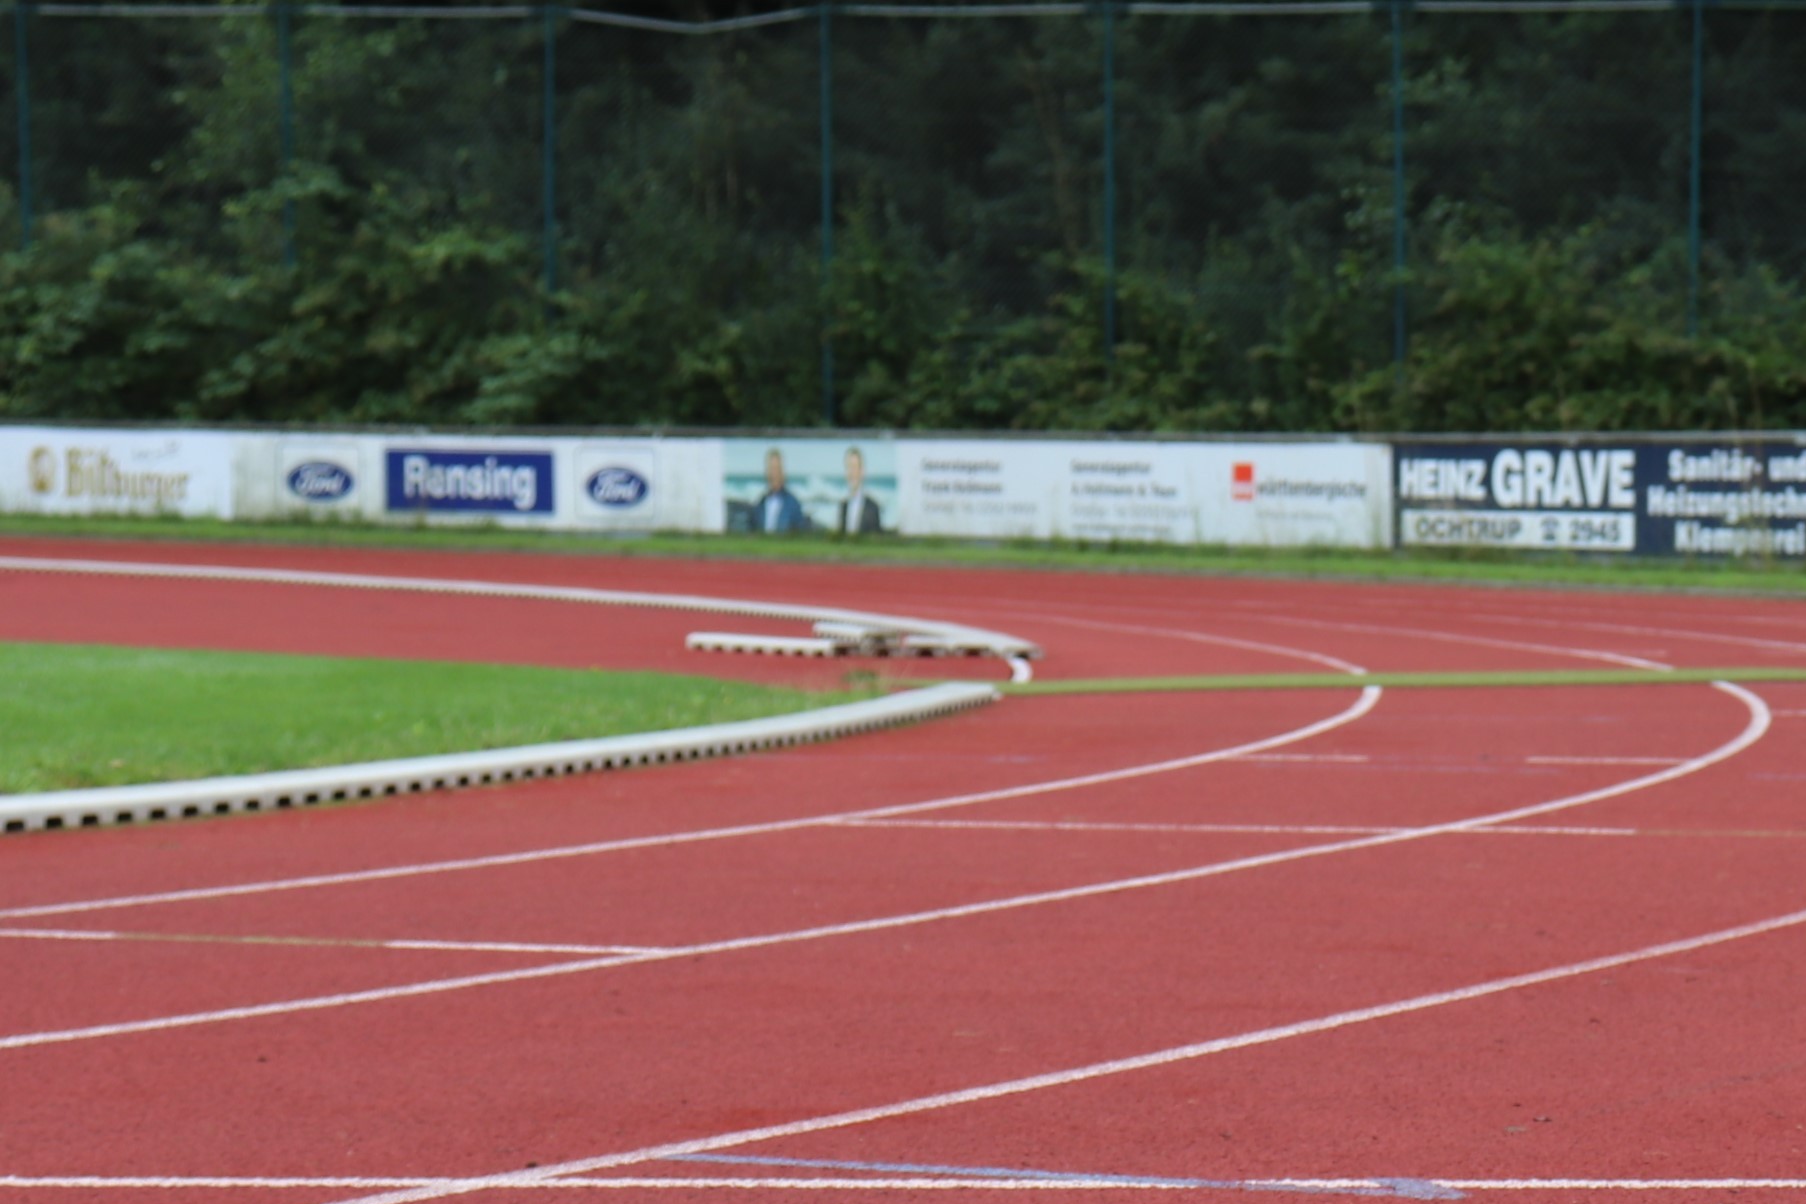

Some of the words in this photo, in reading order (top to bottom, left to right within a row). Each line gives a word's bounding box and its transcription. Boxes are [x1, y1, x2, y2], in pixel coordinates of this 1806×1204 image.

[294, 464, 345, 496] Ford
[593, 470, 640, 502] Ford
[1400, 458, 1488, 500] HEINZ
[1491, 448, 1637, 508] GRAVE
[1415, 516, 1521, 540] OCHTRUP
